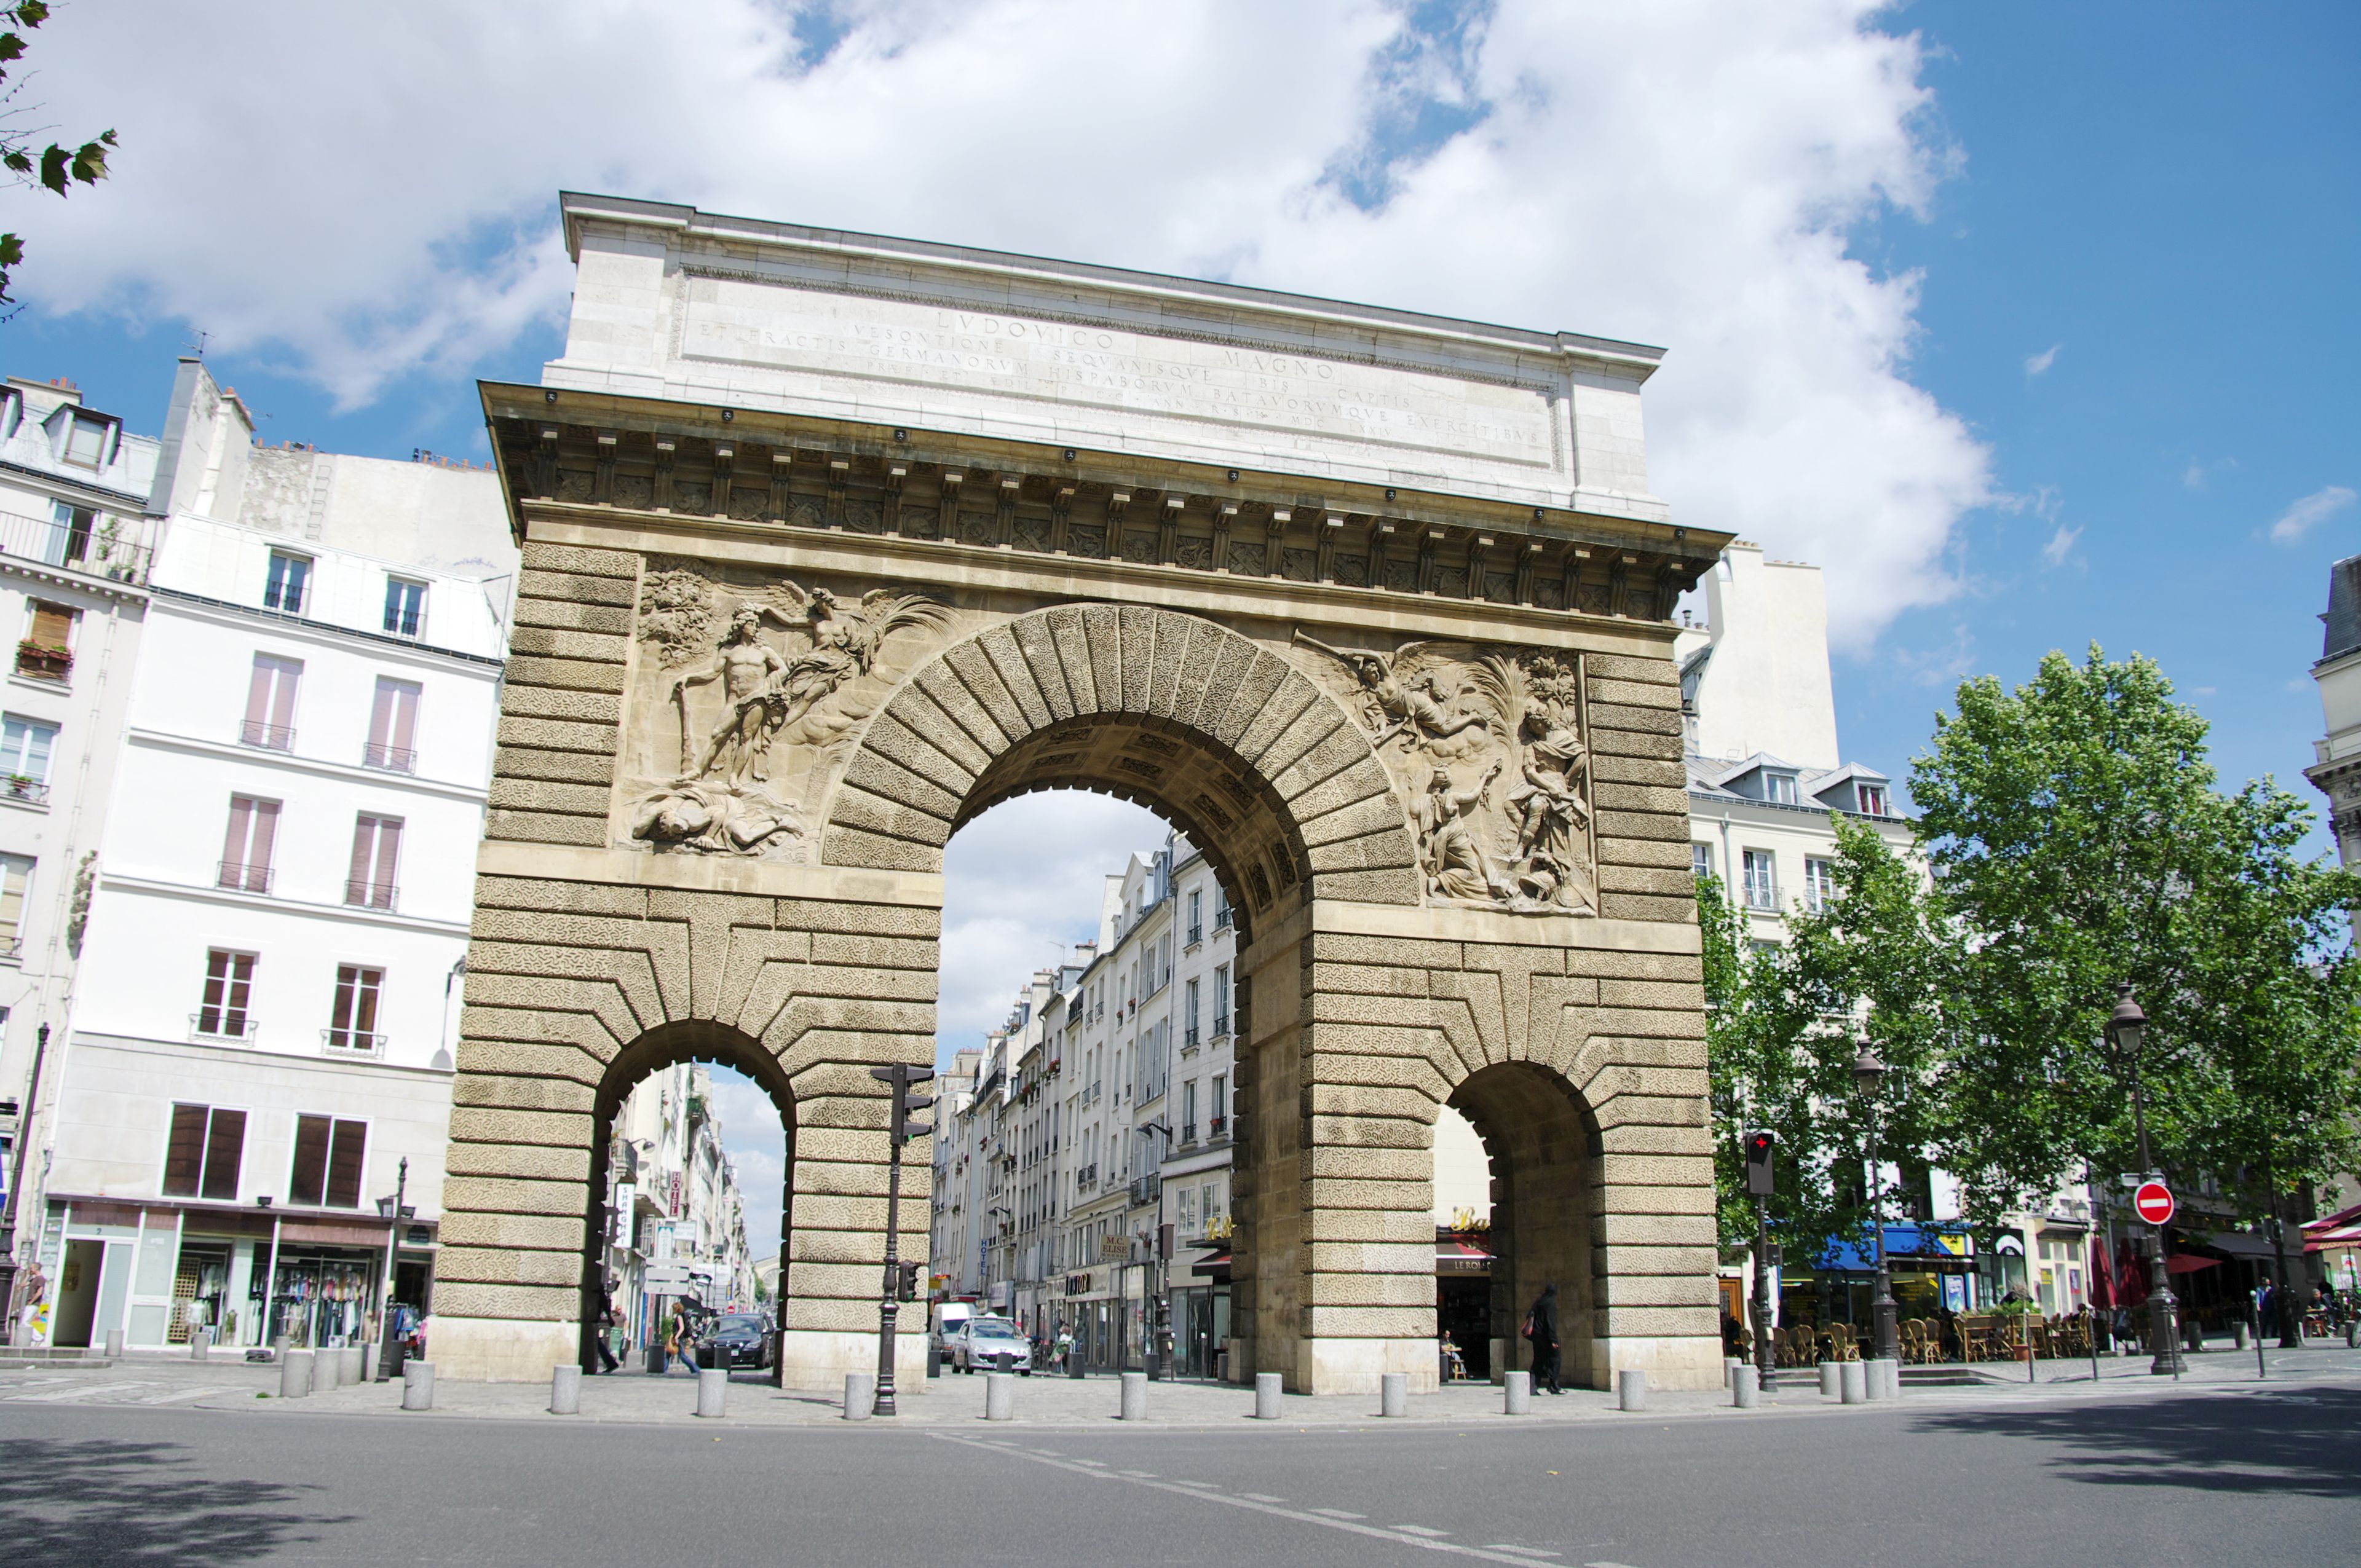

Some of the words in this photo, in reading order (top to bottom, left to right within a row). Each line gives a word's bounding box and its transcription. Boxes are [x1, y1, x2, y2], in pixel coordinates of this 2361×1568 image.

[853, 323, 1005, 355] VESONTIONE
[1053, 350, 1212, 383] SEQVANISQVE
[1259, 377, 1291, 395] BIS
[1338, 388, 1411, 409] CAPTIS
[937, 312, 1113, 349] LVDOVICO
[1224, 350, 1334, 379] MAGNO
[700, 324, 727, 340] ET
[749, 329, 847, 353] FRACTIS
[870, 344, 1030, 377] GERMANORVM
[1213, 387, 1390, 424] BATAVORVMQVE
[1407, 413, 1539, 444] EXERCITIBVS
[620, 1187, 629, 1245] SHANGHAI
[670, 1172, 681, 1216] HOTEL
[1102, 1245, 1127, 1253] ELISE
[1107, 1237, 1125, 1245] M.C.
[1455, 1261, 1465, 1270] LE
[1466, 1261, 1481, 1270] ROI
